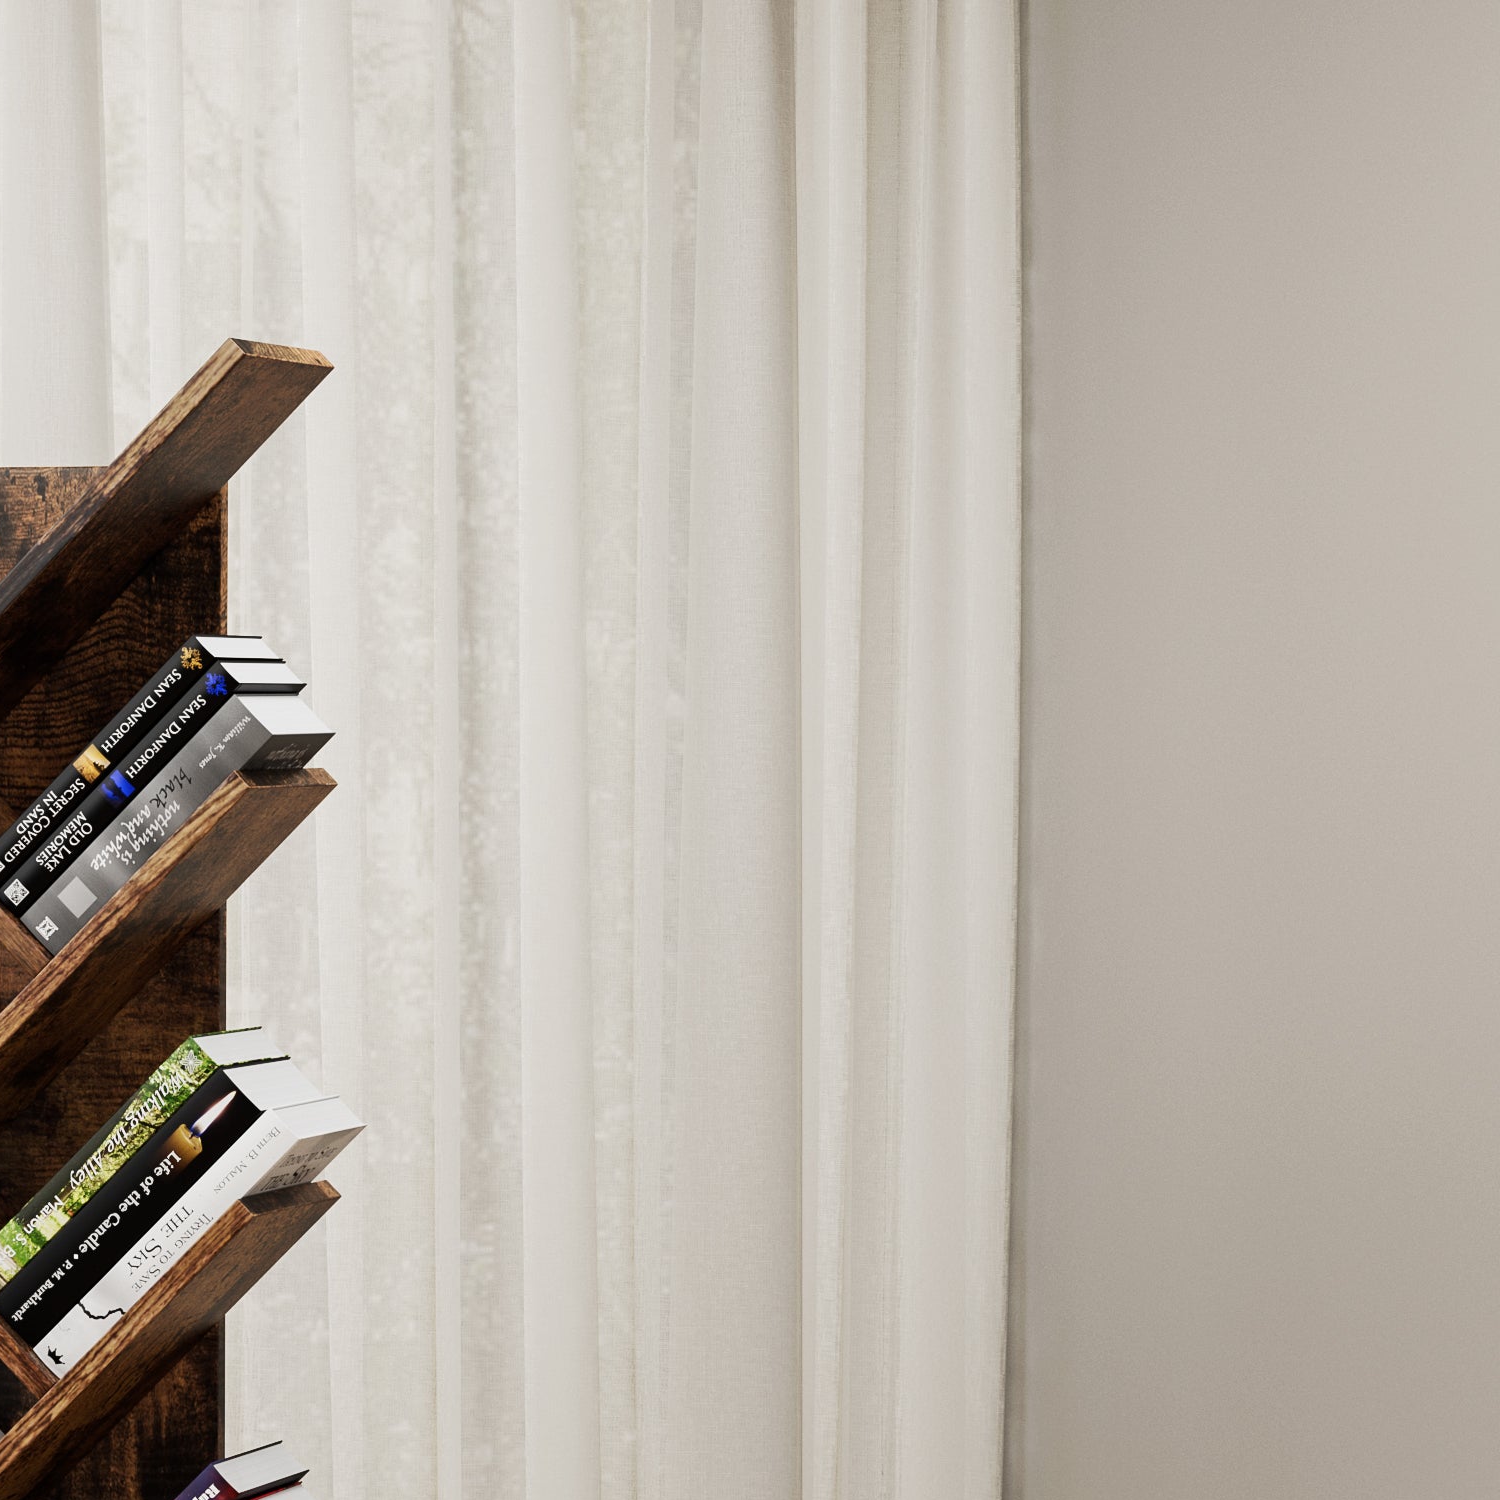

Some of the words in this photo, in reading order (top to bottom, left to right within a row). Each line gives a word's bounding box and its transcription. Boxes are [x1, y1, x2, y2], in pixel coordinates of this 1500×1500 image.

[150, 768, 193, 811] black
[121, 805, 153, 838] and
[127, 800, 182, 852] nothing
[90, 831, 128, 871] white
[120, 850, 137, 865] is
[128, 1071, 186, 1128] Walking
[104, 1126, 133, 1152] the
[69, 1152, 108, 1190] Alley
[153, 1151, 181, 1179] Life
[139, 1175, 158, 1194] of
[118, 1190, 143, 1213] the
[78, 1211, 122, 1256] Candle
[52, 1269, 64, 1281] M.
[63, 1260, 73, 1270] P.
[12, 1279, 54, 1322] Burkhardt
